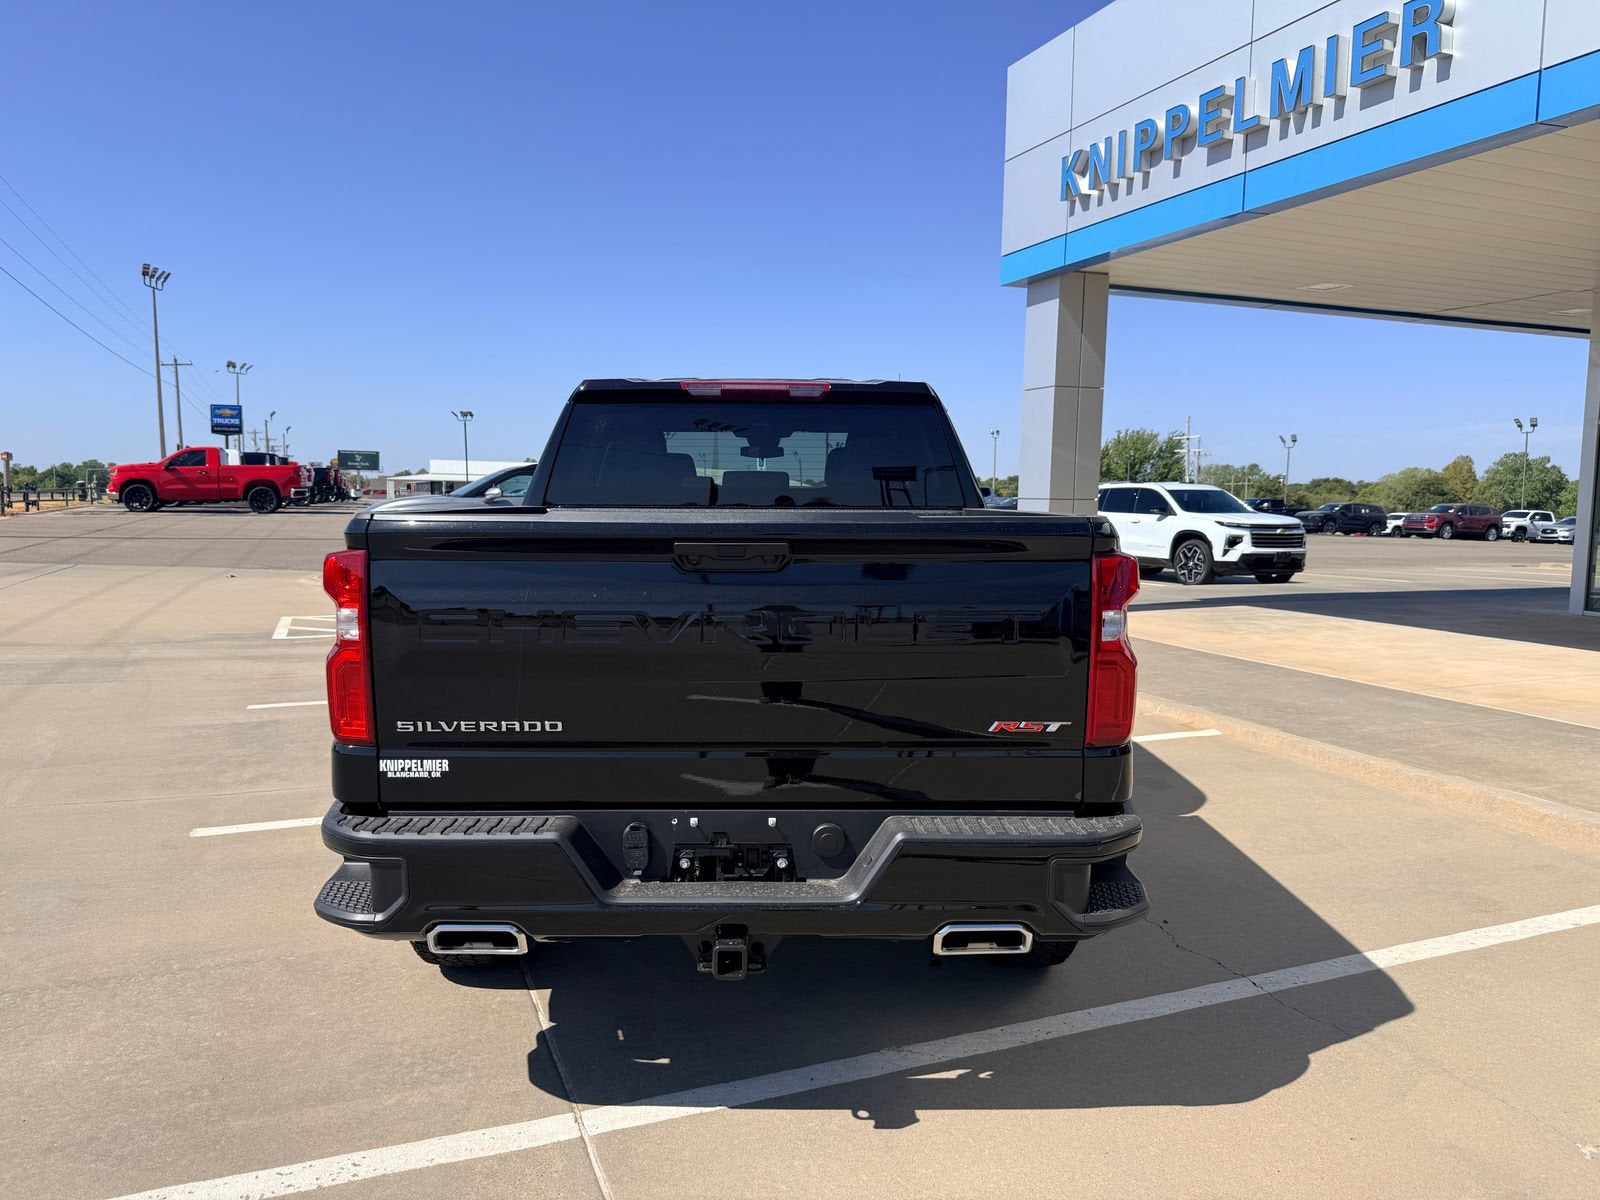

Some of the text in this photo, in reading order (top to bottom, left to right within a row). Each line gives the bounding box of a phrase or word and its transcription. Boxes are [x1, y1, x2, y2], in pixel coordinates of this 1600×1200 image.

[1060, 0, 1452, 202] KNIPPELMIER
[396, 720, 563, 732] SILVERADO
[988, 720, 1072, 732] RST
[379, 759, 449, 772] KNIPPELMIER
[387, 771, 430, 779] BLANCHARD,
